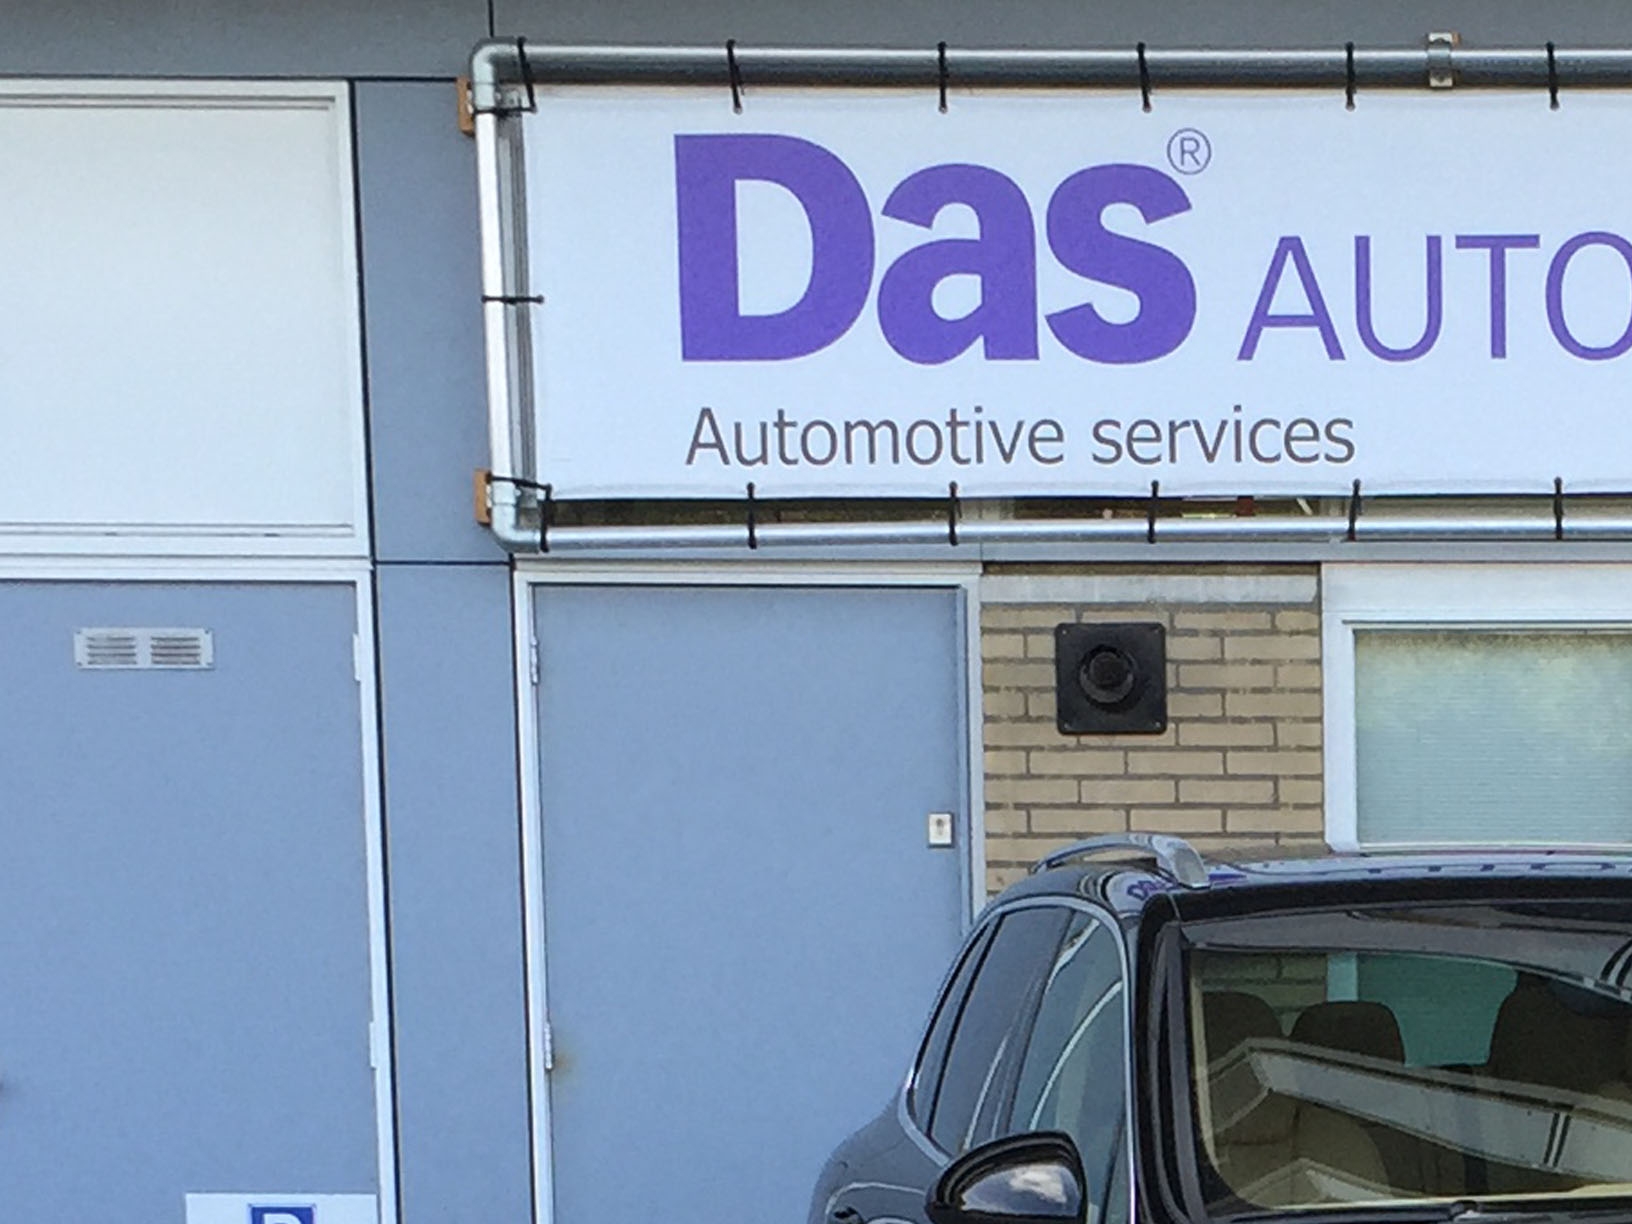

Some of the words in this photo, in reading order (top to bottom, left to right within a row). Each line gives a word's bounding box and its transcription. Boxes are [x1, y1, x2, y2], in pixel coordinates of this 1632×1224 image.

[674, 133, 1197, 365] Das
[685, 405, 1064, 467] Automotive
[1091, 404, 1355, 465] services
